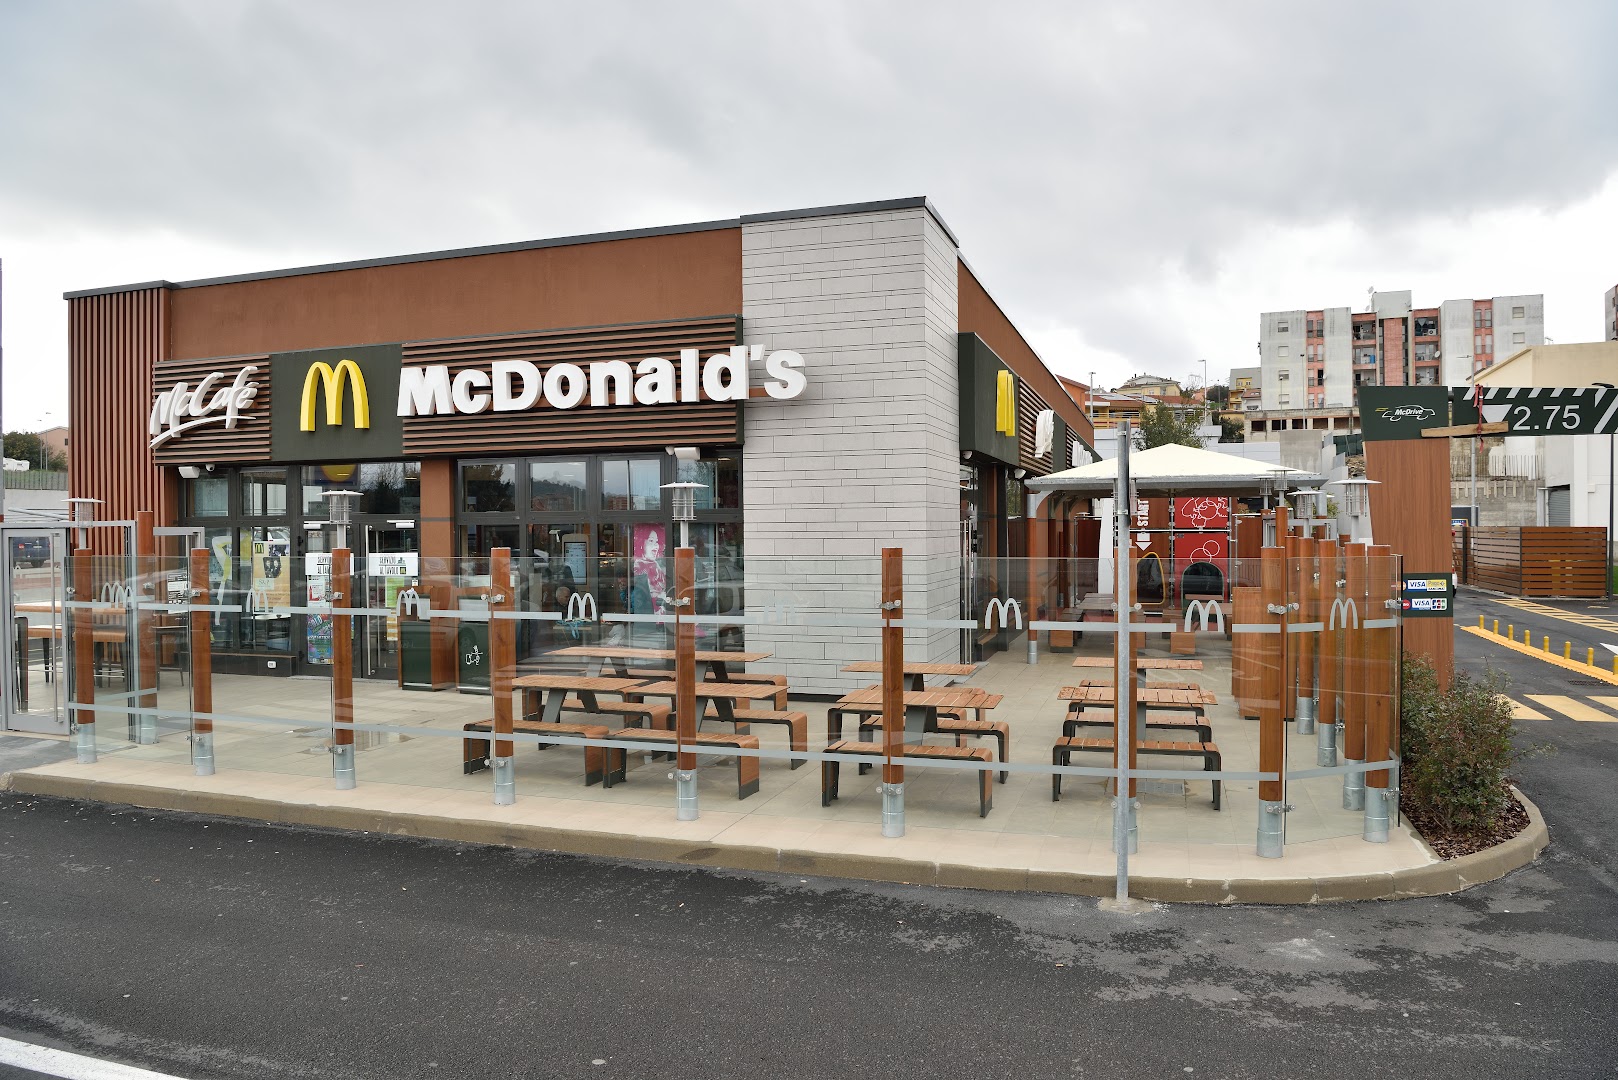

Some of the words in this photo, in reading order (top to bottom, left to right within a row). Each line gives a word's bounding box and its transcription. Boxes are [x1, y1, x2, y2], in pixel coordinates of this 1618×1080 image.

[396, 343, 807, 417] McDonald's
[149, 365, 259, 438] McCafé
[1394, 408, 1424, 416] McDrive
[1512, 404, 1581, 431] 2.75
[1137, 499, 1149, 527] START
